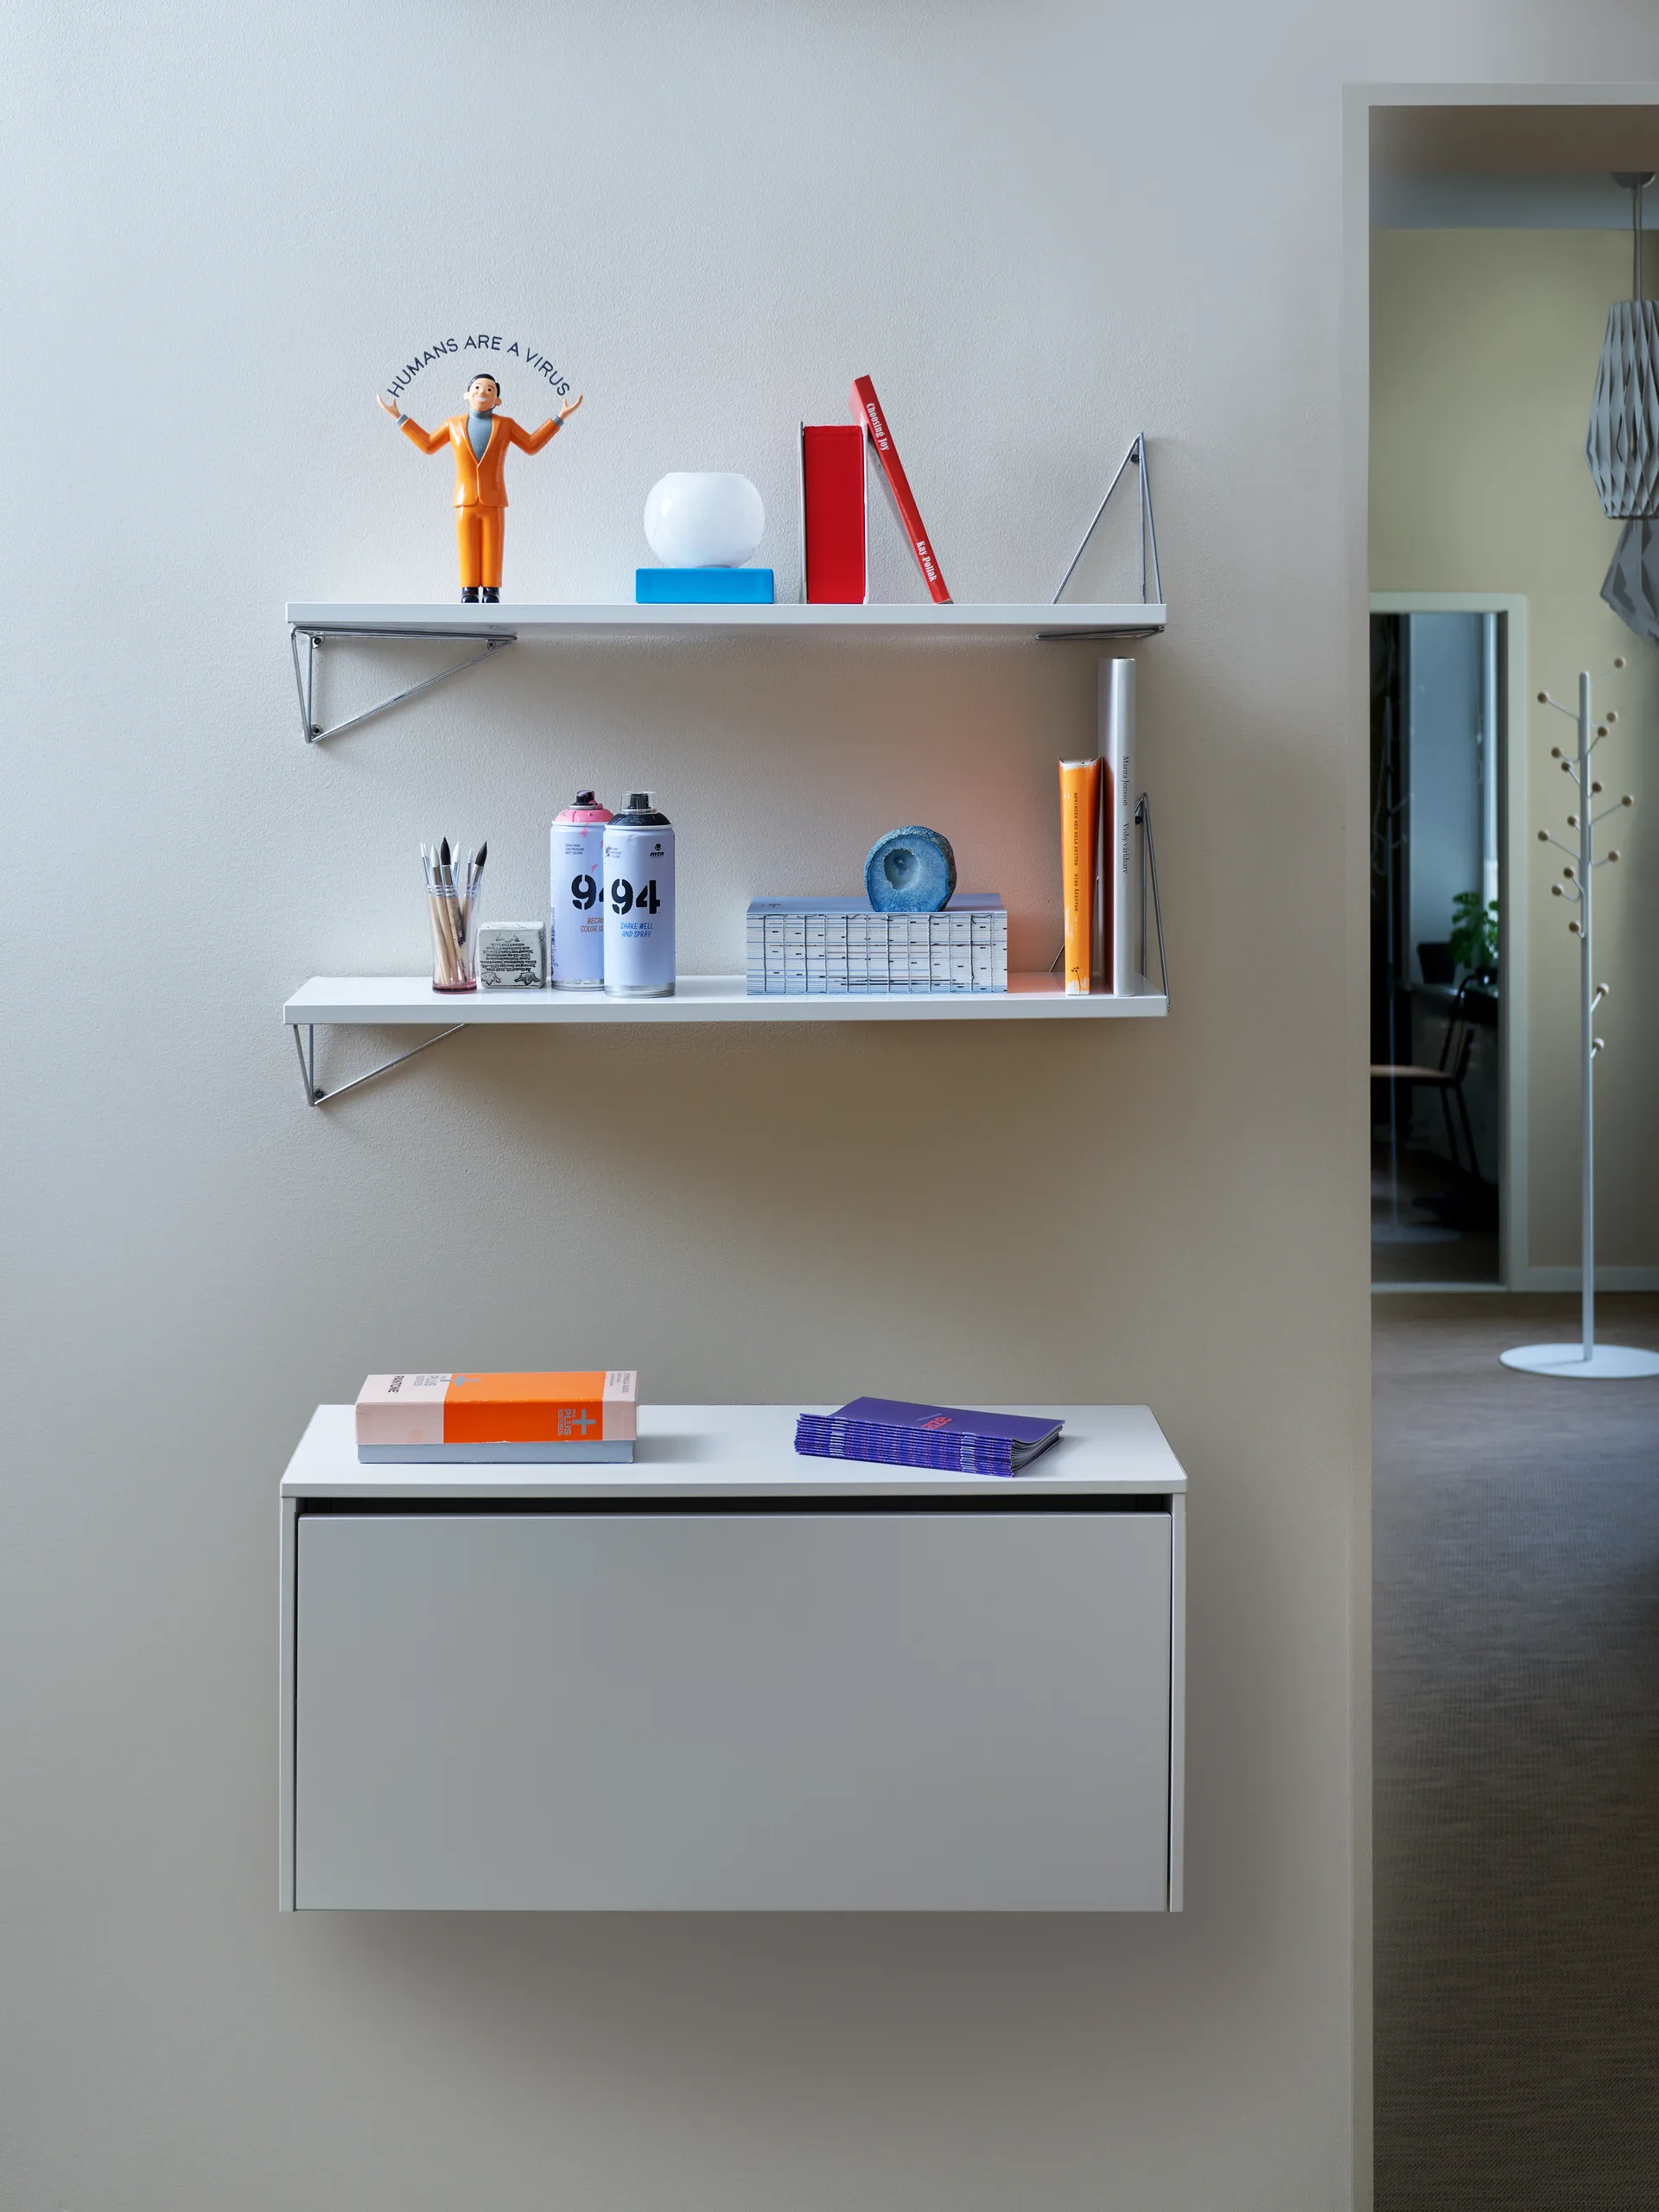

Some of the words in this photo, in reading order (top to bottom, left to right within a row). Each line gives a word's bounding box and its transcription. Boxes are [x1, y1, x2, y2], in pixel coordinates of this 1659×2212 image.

[387, 338, 459, 397] HUMANS
[464, 334, 502, 351] ARE
[506, 341, 520, 357] A
[525, 347, 570, 397] VIRUS
[867, 403, 886, 438] Choosing
[878, 437, 890, 451] Joy
[917, 541, 928, 556] Kay
[922, 556, 938, 582] Pollak
[1121, 823, 1129, 842] Visby
[611, 879, 660, 915] 94
[388, 1376, 404, 1393] PANTONE
